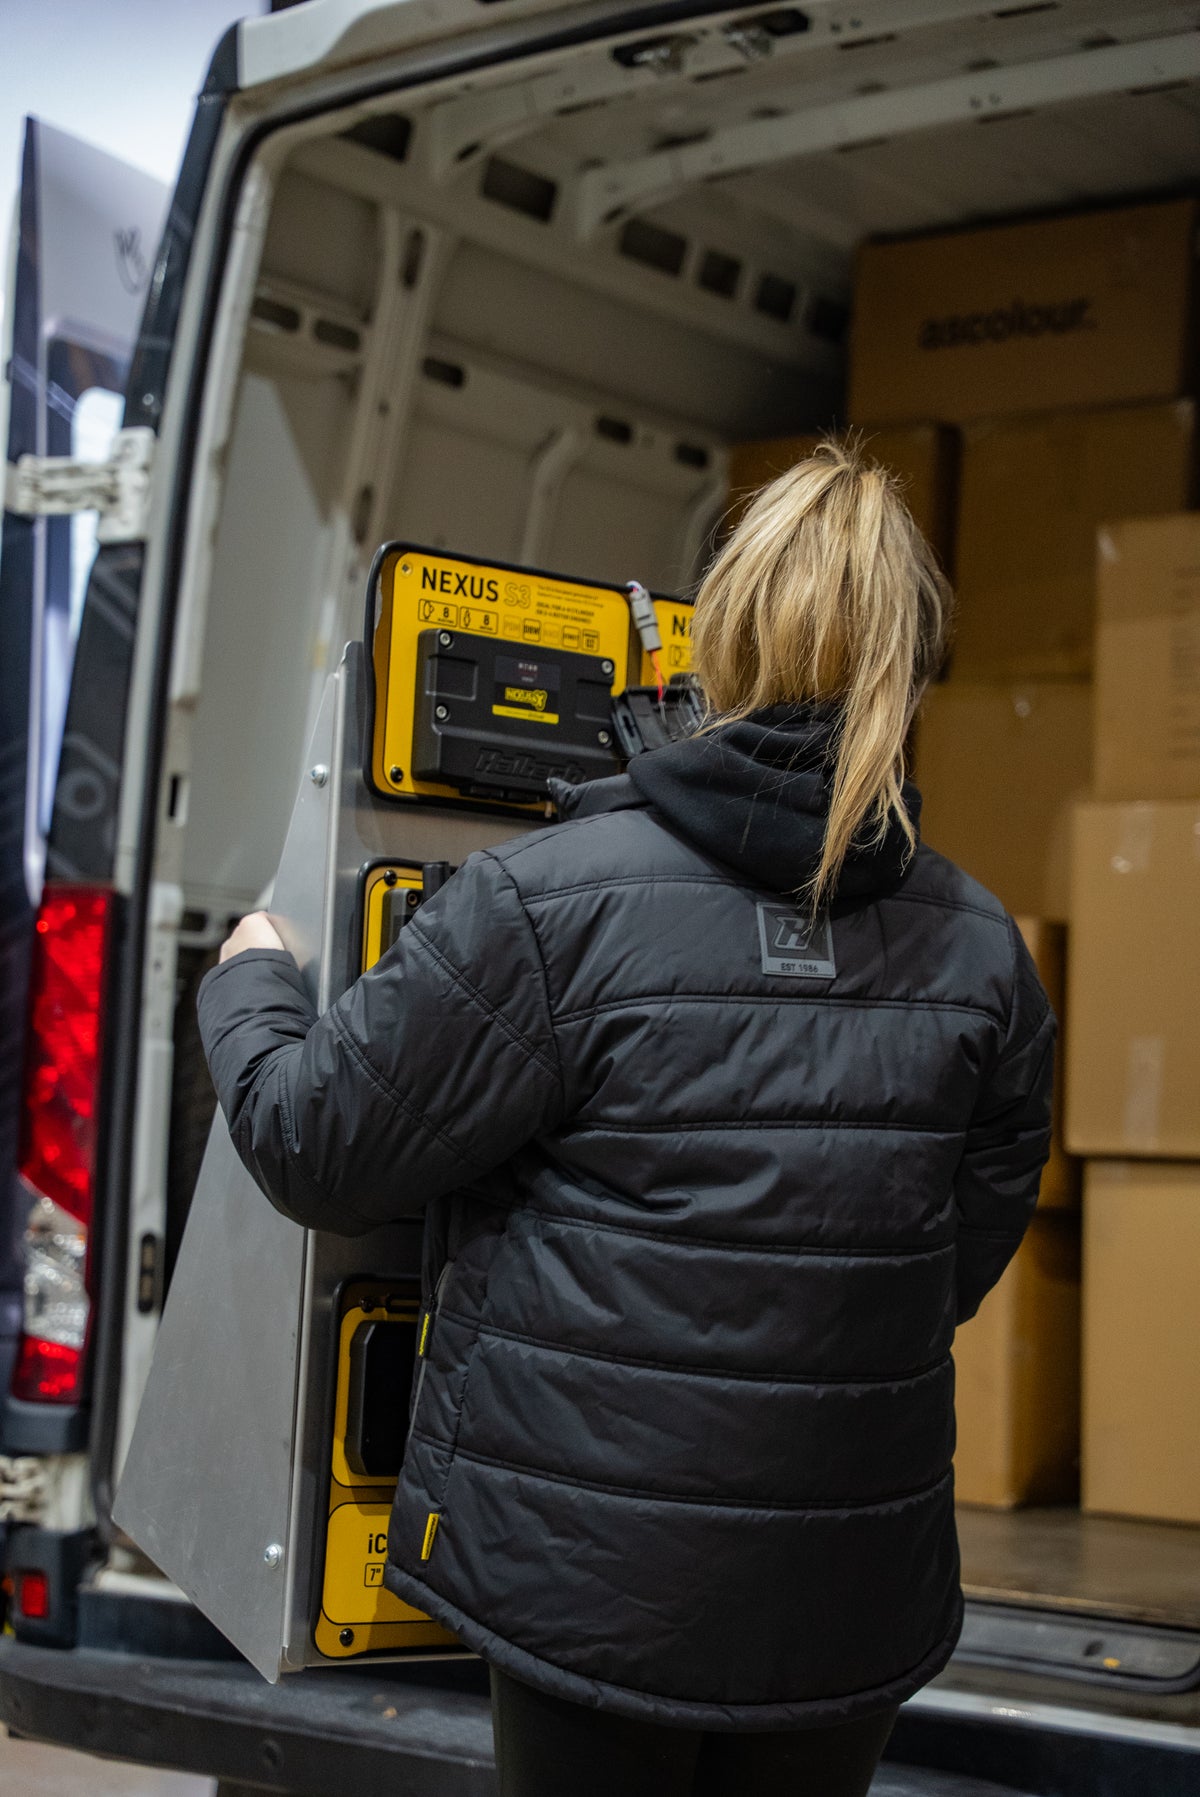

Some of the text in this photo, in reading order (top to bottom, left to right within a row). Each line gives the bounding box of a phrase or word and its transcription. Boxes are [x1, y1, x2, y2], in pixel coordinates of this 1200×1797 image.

[421, 567, 499, 602] NEXUS
[504, 582, 531, 609] S3
[443, 607, 450, 618] 8
[483, 615, 490, 626] 8
[780, 962, 819, 973] EST 1986
